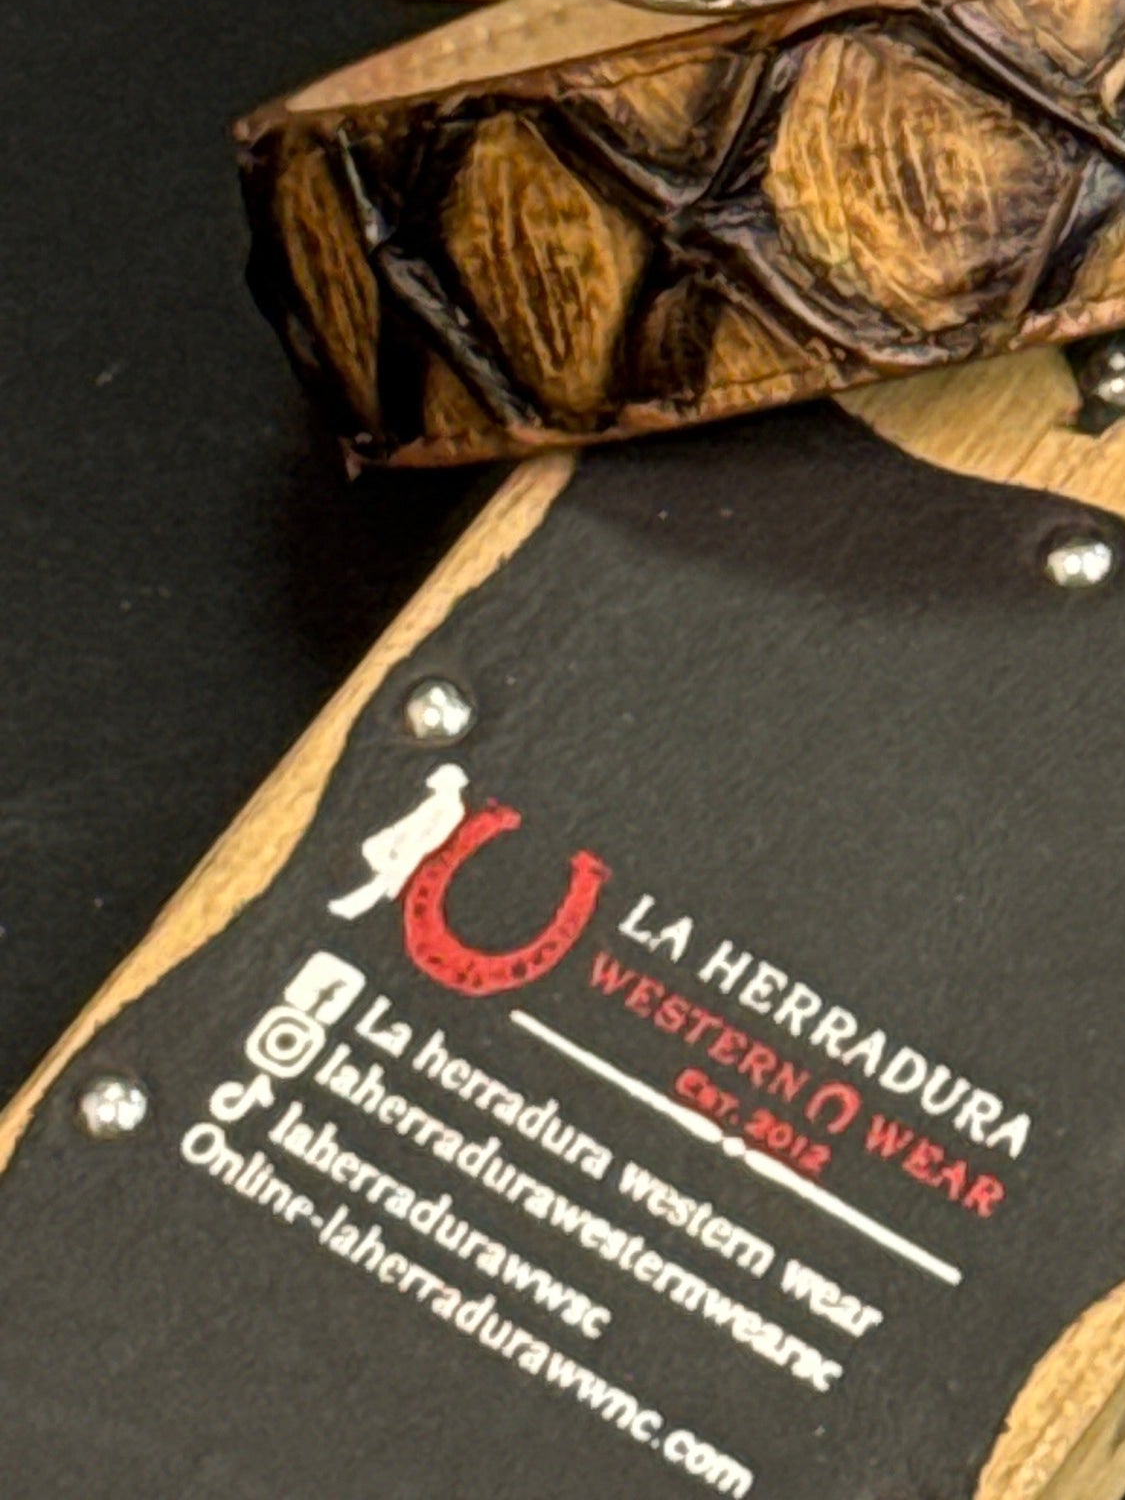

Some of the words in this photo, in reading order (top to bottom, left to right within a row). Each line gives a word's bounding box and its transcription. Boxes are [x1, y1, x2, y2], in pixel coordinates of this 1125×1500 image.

[588, 950, 811, 1103] WESTERN
[864, 1113, 1006, 1219] WEAR
[618, 894, 694, 964] LA
[698, 939, 1031, 1160] HERRADURA
[743, 1108, 832, 1174] 2012
[354, 994, 413, 1059] La
[411, 1028, 613, 1181] herradura
[617, 1161, 776, 1280] western
[780, 1257, 884, 1354] wear
